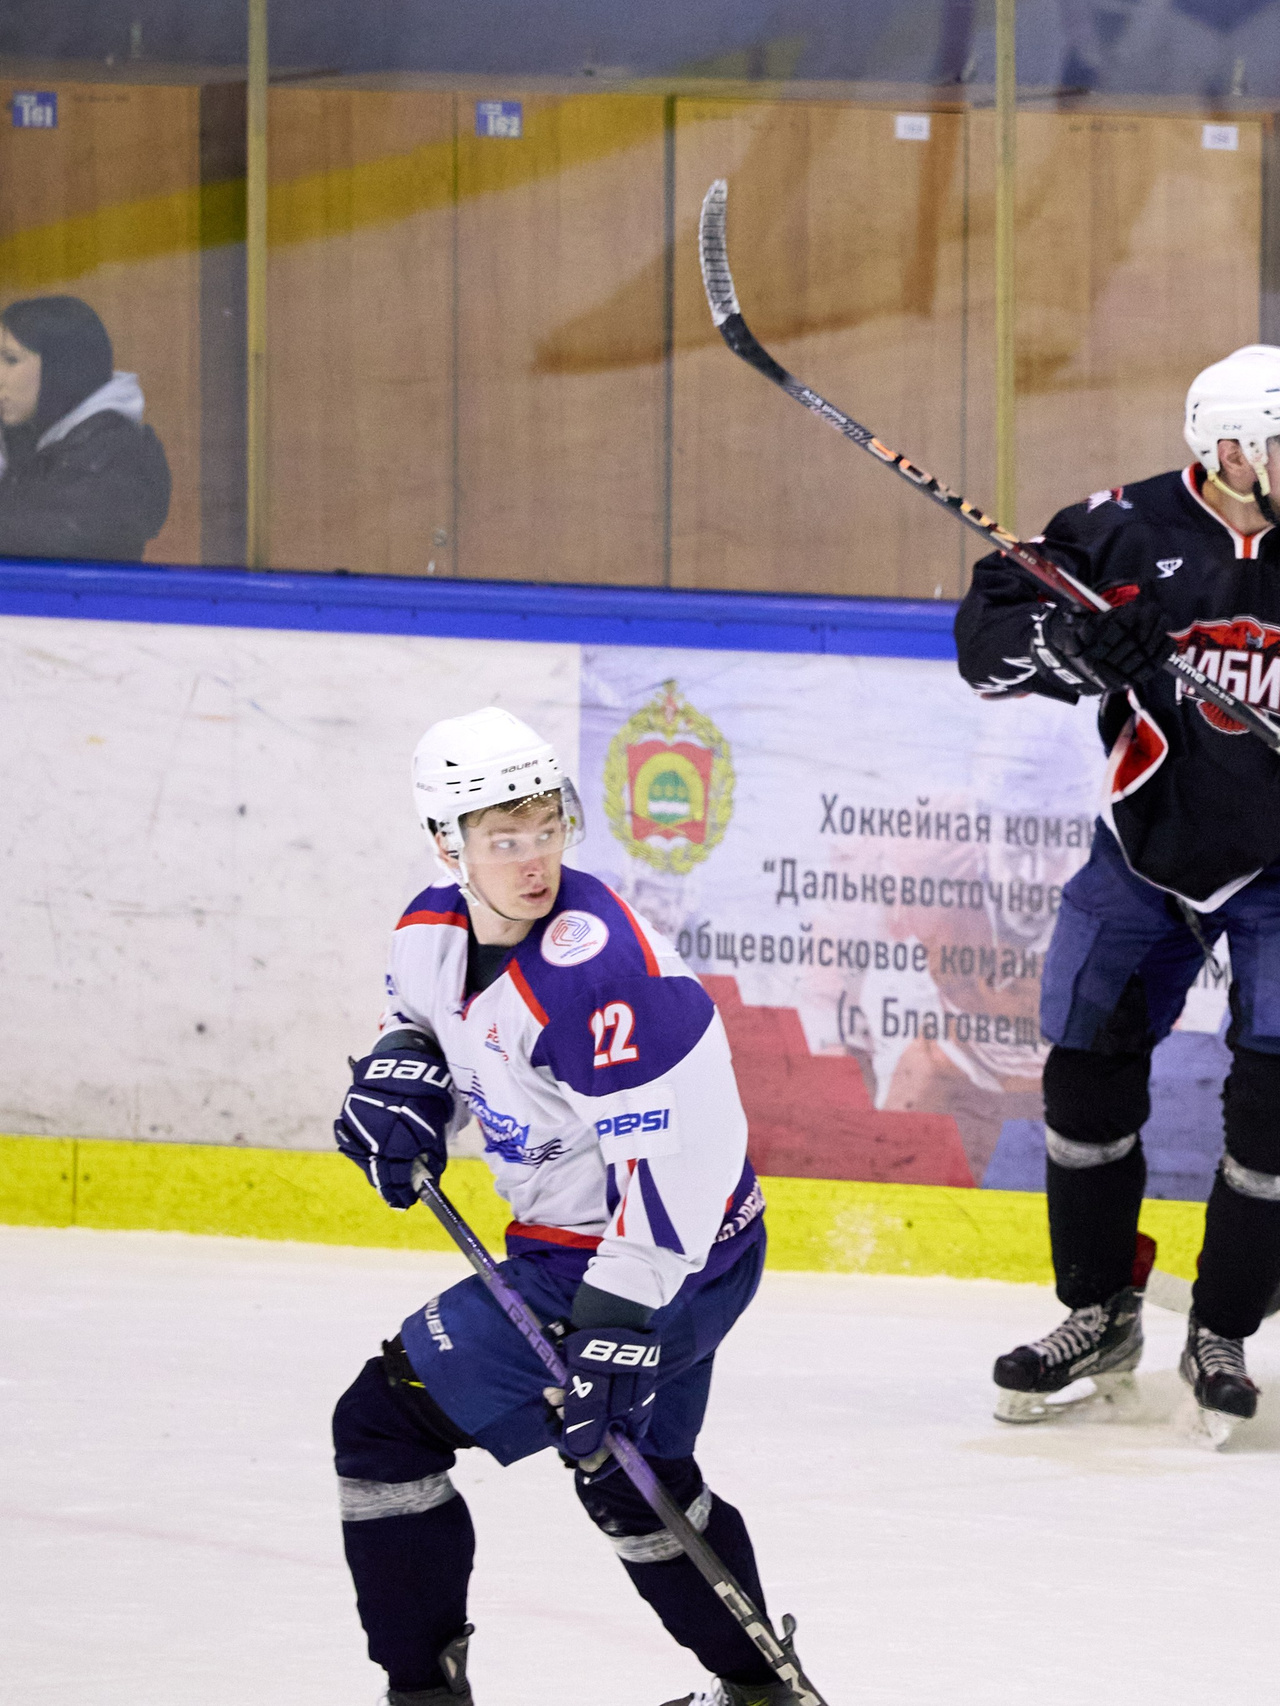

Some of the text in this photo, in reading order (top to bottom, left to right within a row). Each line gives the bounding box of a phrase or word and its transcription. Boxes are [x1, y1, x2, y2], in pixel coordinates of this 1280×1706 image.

[868, 437, 1019, 550] SOYUZ
[819, 792, 992, 844] Хоккейная
[676, 919, 1039, 978] общевойсковое коман
[588, 1000, 640, 1070] 22
[881, 996, 1040, 1051] Благовещ
[363, 1058, 452, 1089] BAU
[594, 1108, 670, 1140] PEPSI
[424, 1296, 454, 1352] UER
[579, 1338, 661, 1368] BAU
